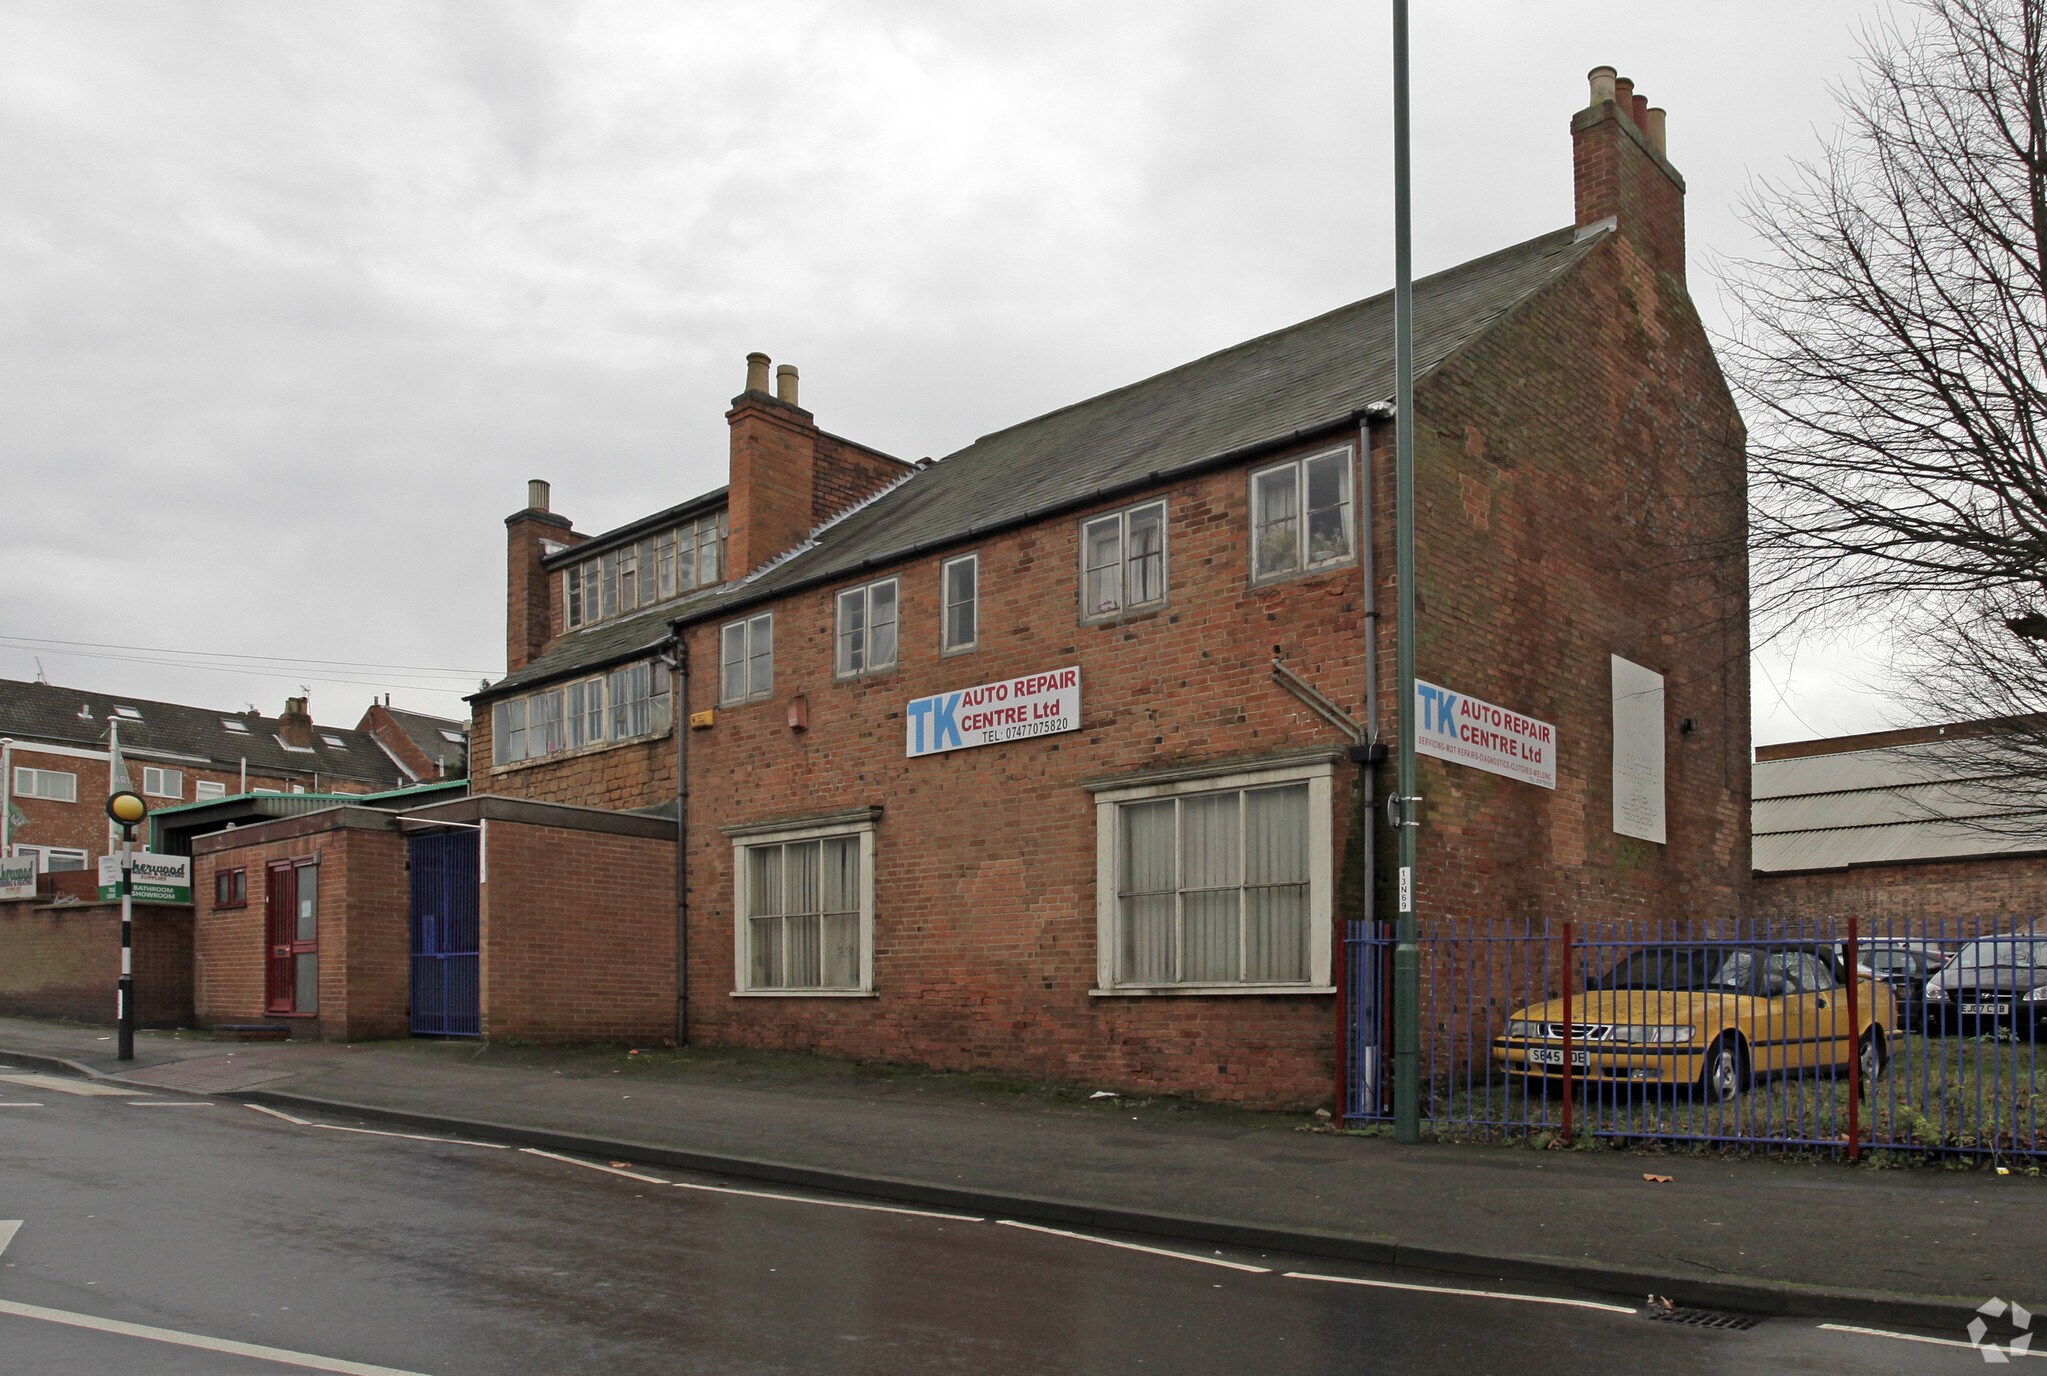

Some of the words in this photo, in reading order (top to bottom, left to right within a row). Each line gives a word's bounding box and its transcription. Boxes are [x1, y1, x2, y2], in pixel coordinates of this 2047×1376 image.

[962, 684, 1008, 708] AUTO
[1014, 670, 1076, 698] REPAIR
[908, 692, 963, 753] TK
[961, 705, 1027, 732] CENTRE
[1033, 699, 1060, 720] Ltd
[1418, 684, 1458, 738] TK
[1460, 699, 1501, 727] AUTO
[1504, 713, 1551, 744] REPAIR
[982, 730, 1003, 743] TEL:
[1006, 717, 1068, 739] 07477075820
[1460, 724, 1518, 757] CENTRE
[1521, 742, 1542, 764] Ltd
[121, 859, 185, 875] herwood
[131, 890, 176, 899] SHOWROOM
[133, 884, 174, 893] BATHROOM
[1986, 1004, 2005, 1013] CB
